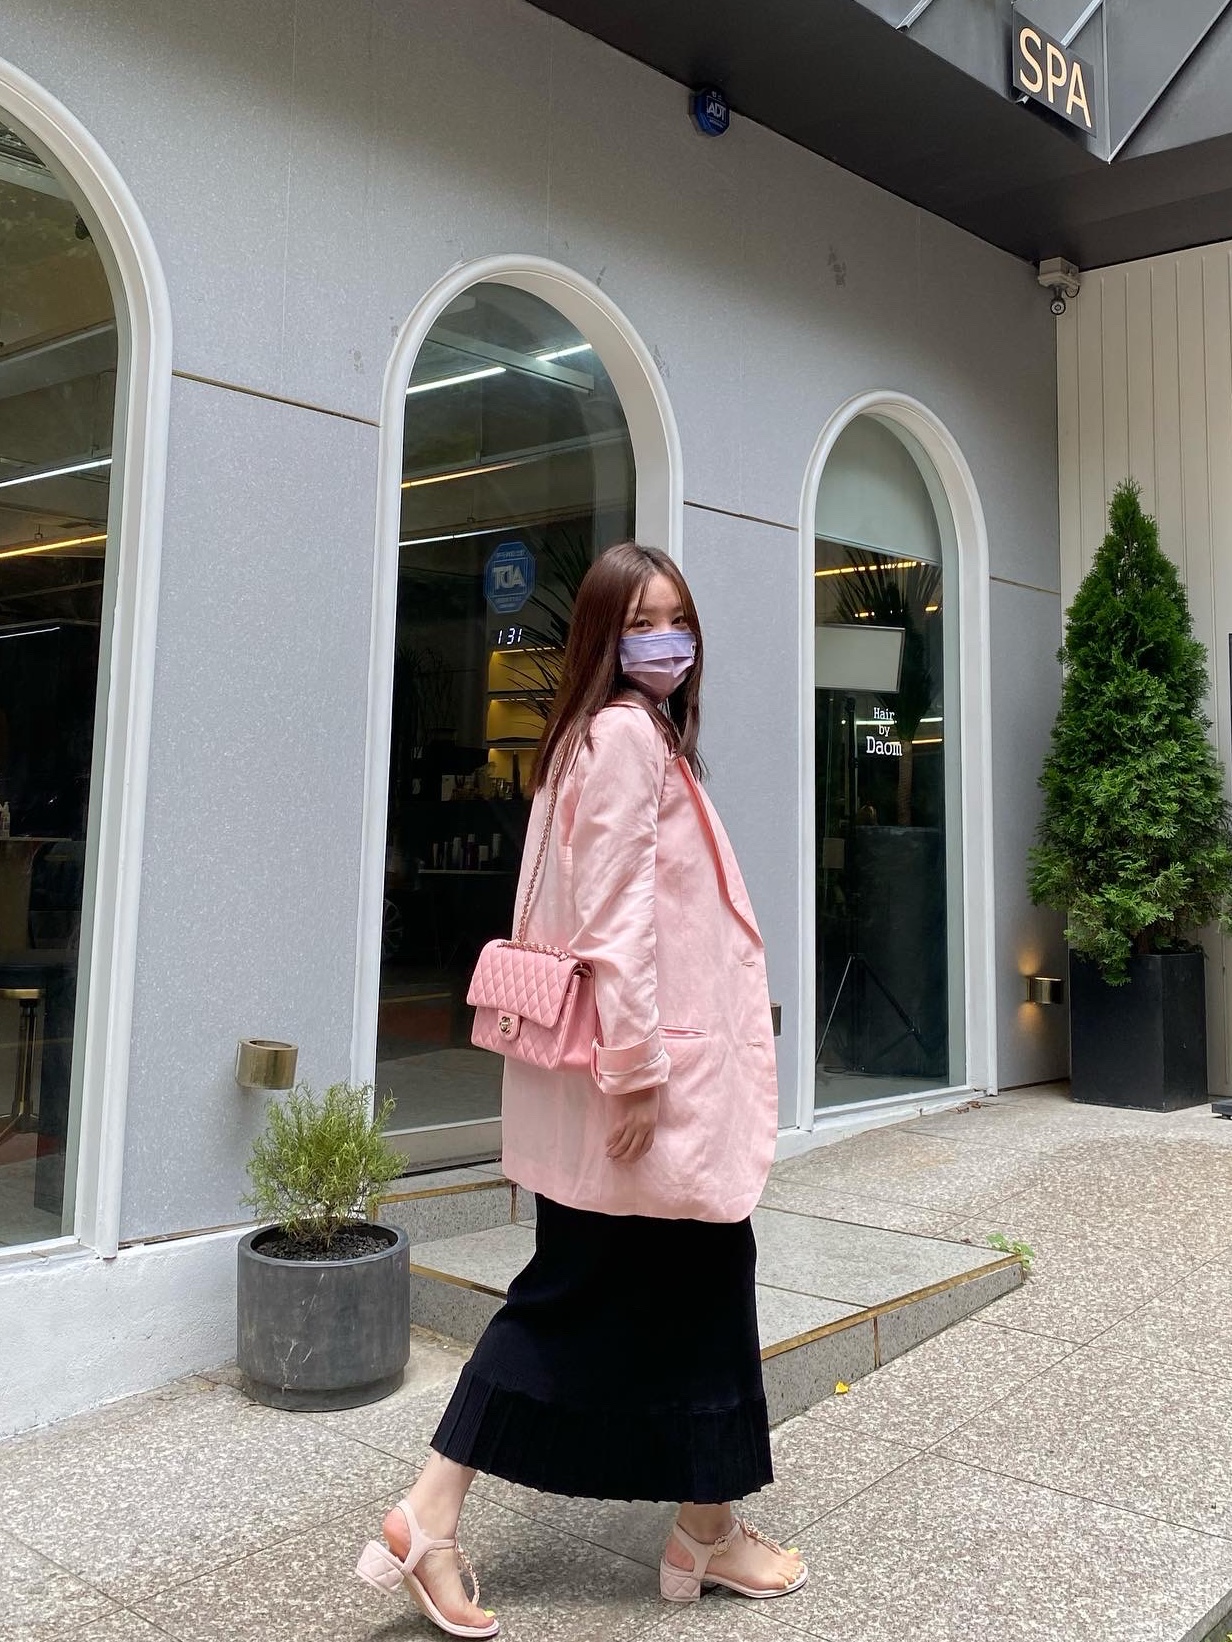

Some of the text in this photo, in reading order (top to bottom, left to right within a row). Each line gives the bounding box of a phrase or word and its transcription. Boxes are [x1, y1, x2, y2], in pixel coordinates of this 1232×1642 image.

[1019, 27, 1092, 128] SPA
[707, 102, 726, 121] ADT
[873, 706, 895, 720] Hair
[878, 723, 890, 737] by
[866, 735, 903, 756] Daom
